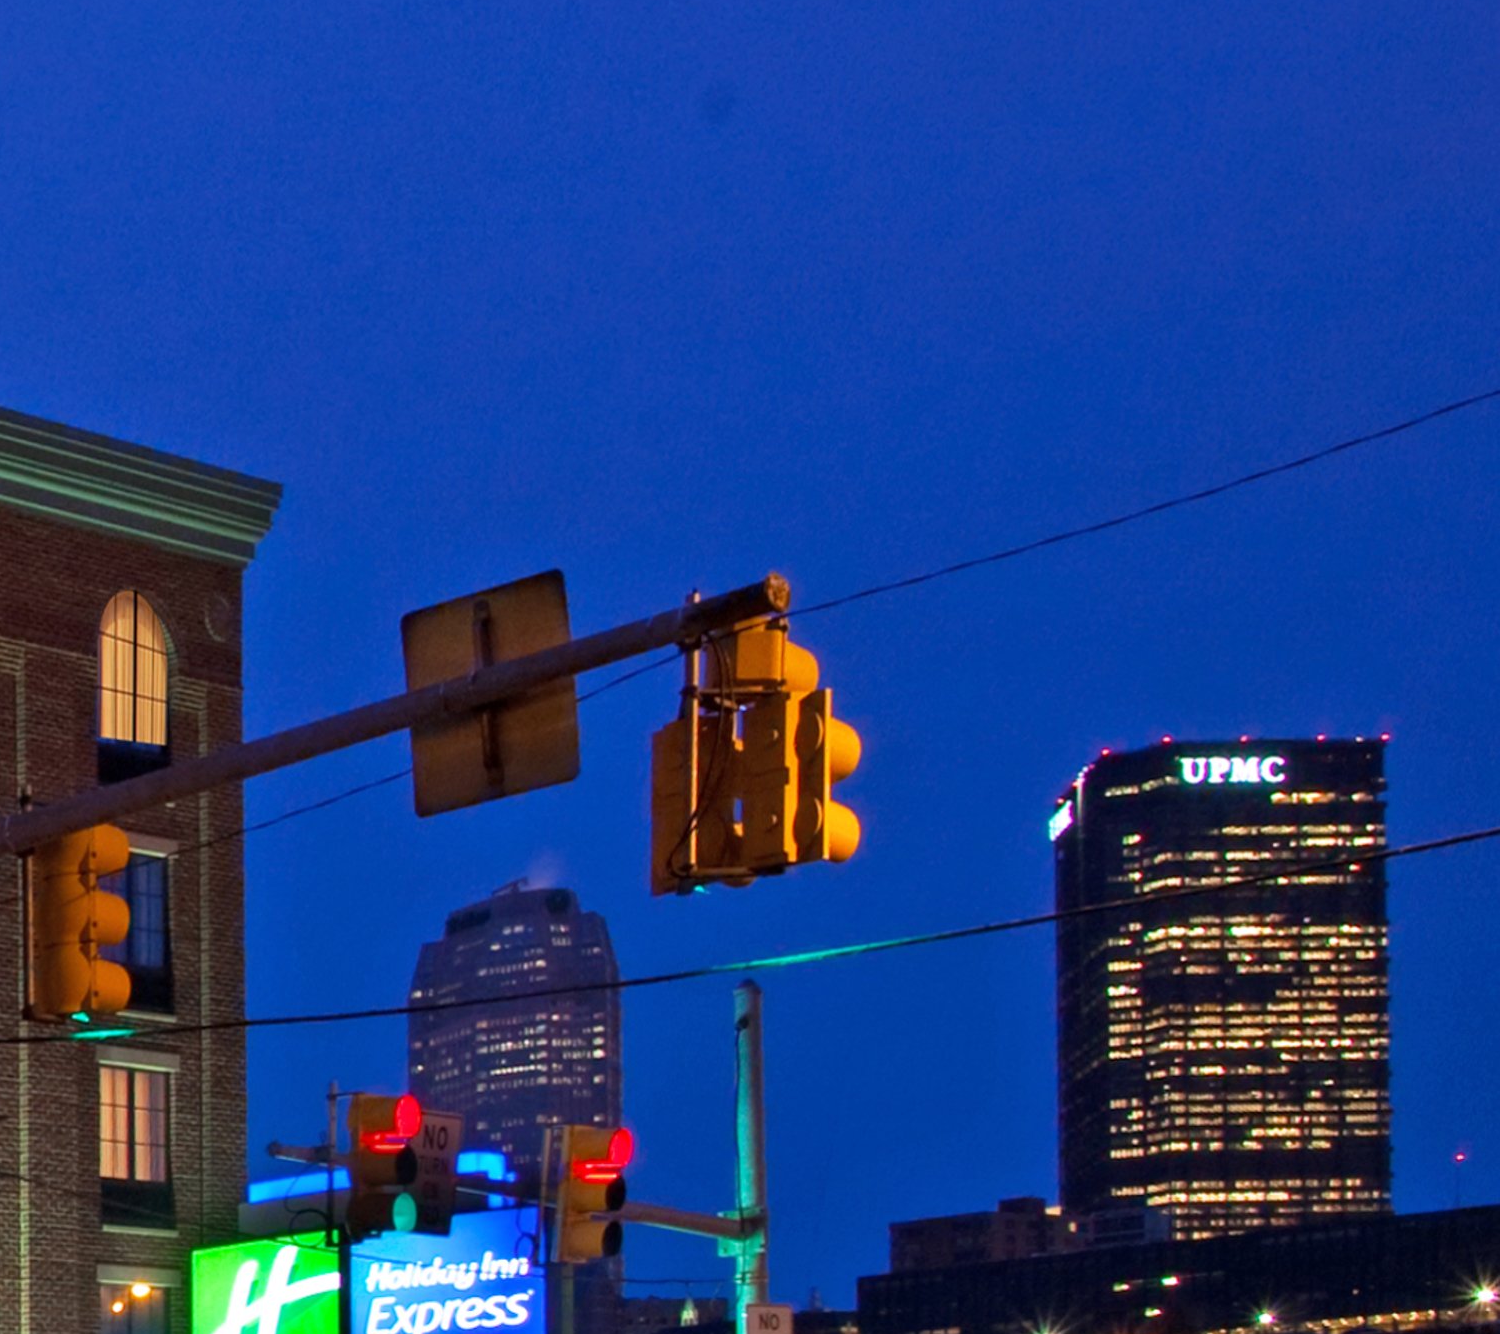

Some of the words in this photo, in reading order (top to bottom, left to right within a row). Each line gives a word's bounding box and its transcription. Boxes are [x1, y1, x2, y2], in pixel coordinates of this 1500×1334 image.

[1179, 756, 1286, 784] UPMC
[422, 1125, 448, 1150] NO
[365, 1256, 478, 1293] Holiday
[479, 1251, 529, 1281] Inn
[759, 1313, 780, 1330] NO
